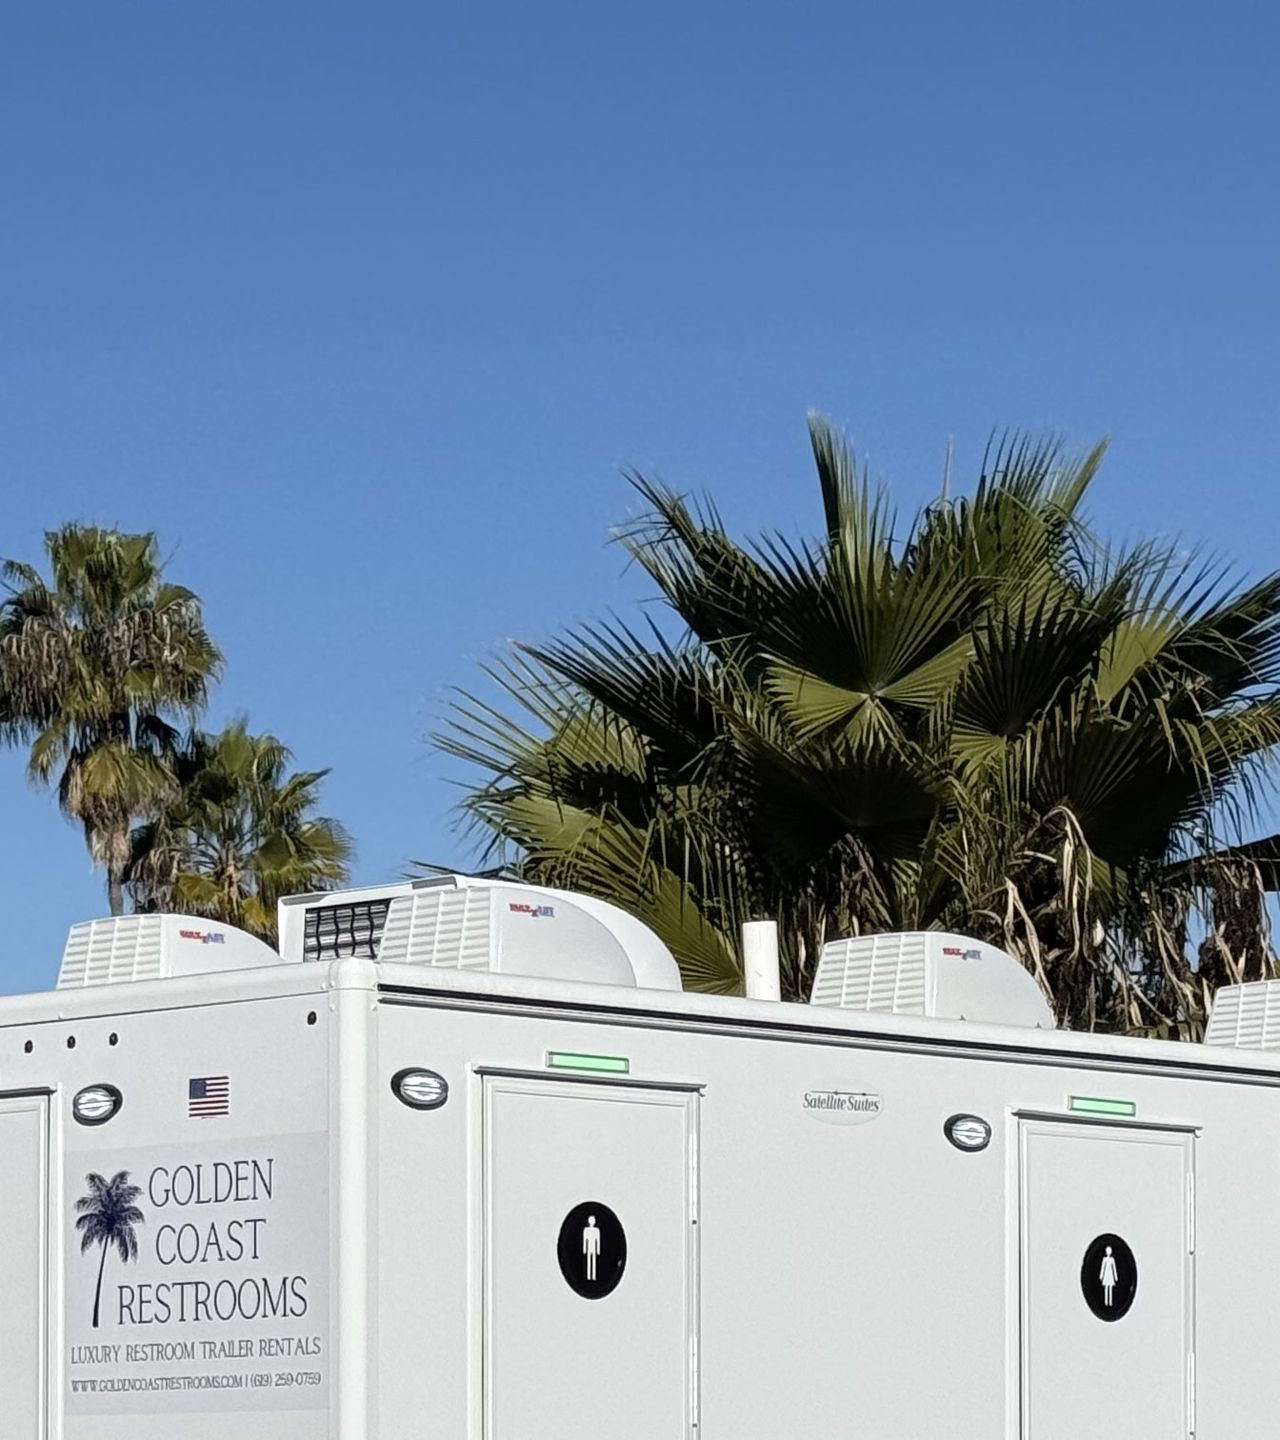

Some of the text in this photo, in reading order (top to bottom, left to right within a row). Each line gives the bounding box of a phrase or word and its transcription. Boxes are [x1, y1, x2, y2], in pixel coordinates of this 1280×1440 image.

[803, 1092, 879, 1113] Satellite Suites
[148, 1158, 274, 1208] GOLDEN
[155, 1218, 267, 1265] COAST
[117, 1275, 308, 1326] RESTROOMS
[71, 1336, 321, 1364] LUXURY RESTROOM TRAILER RENTALS
